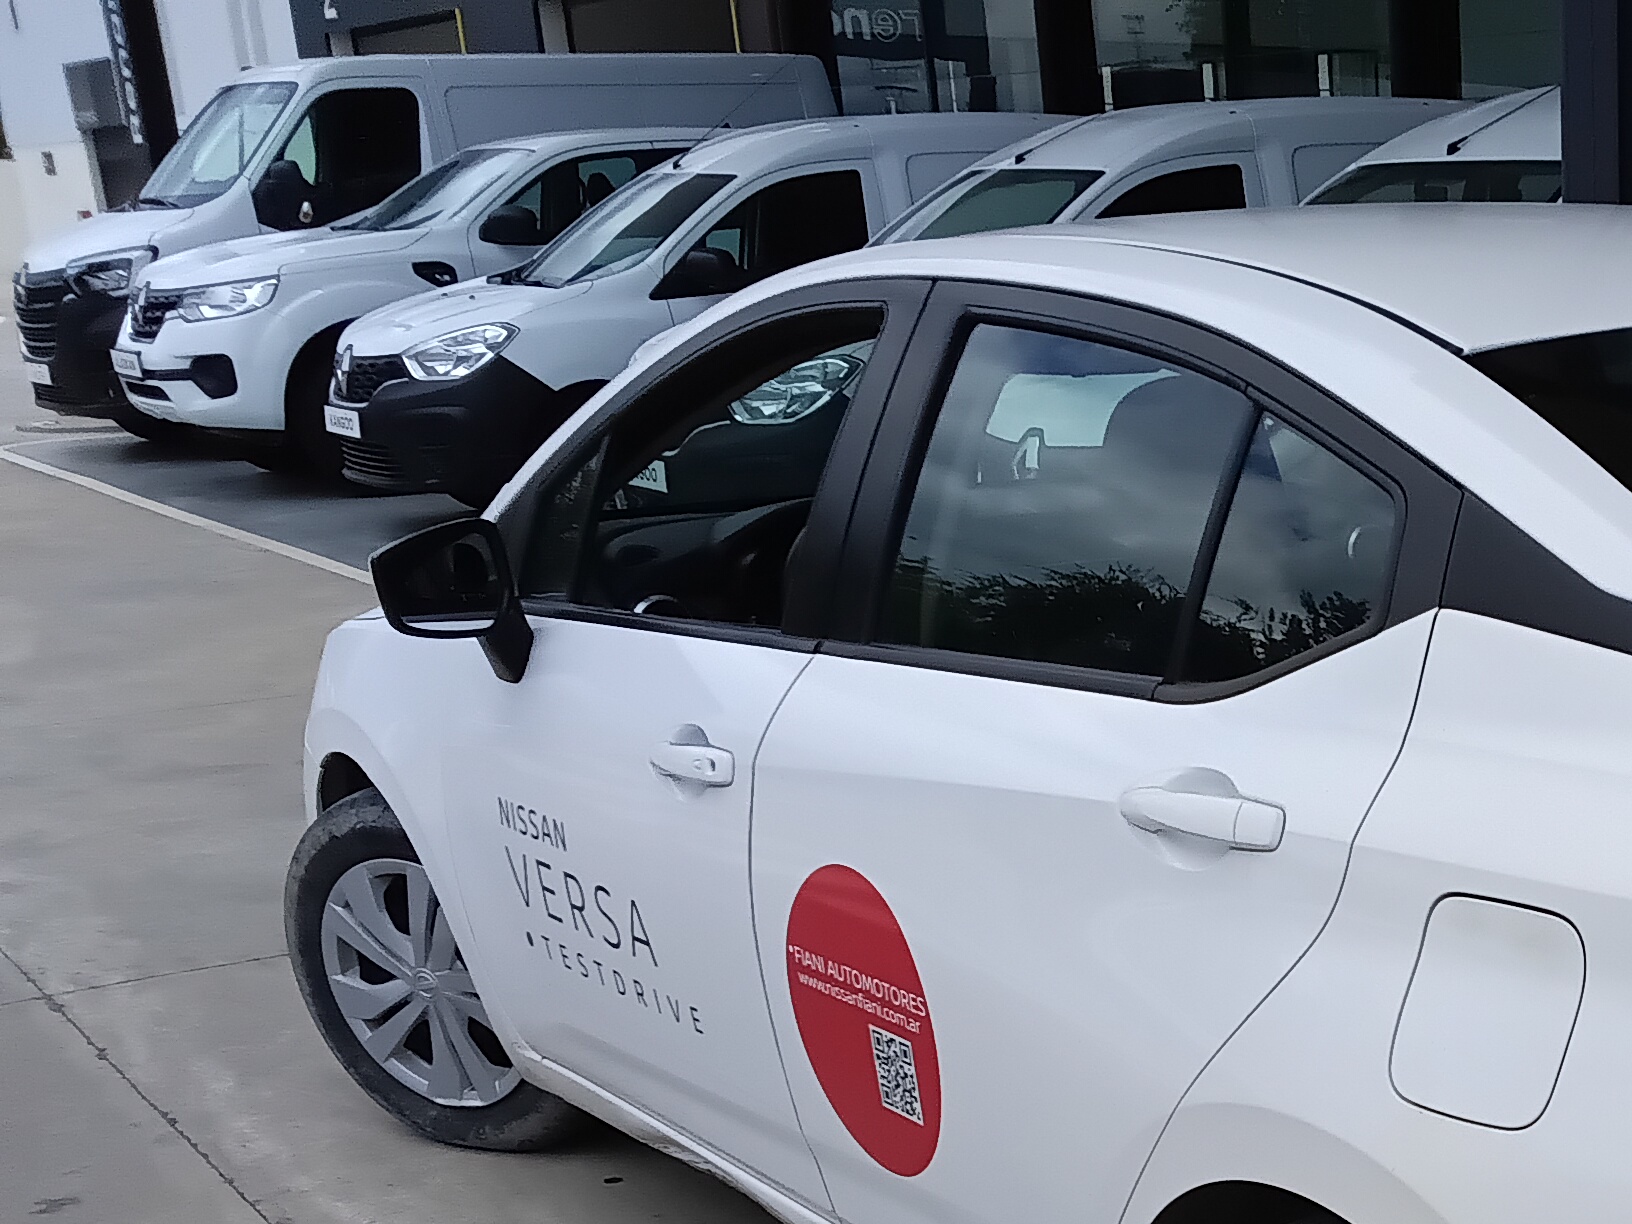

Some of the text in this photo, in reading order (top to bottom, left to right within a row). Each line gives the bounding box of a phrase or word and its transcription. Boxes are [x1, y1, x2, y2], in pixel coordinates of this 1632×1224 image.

[498, 797, 567, 852] NISSAN
[505, 846, 658, 967] VERSA
[793, 945, 926, 1017] FIANI AUTOMOTORES
